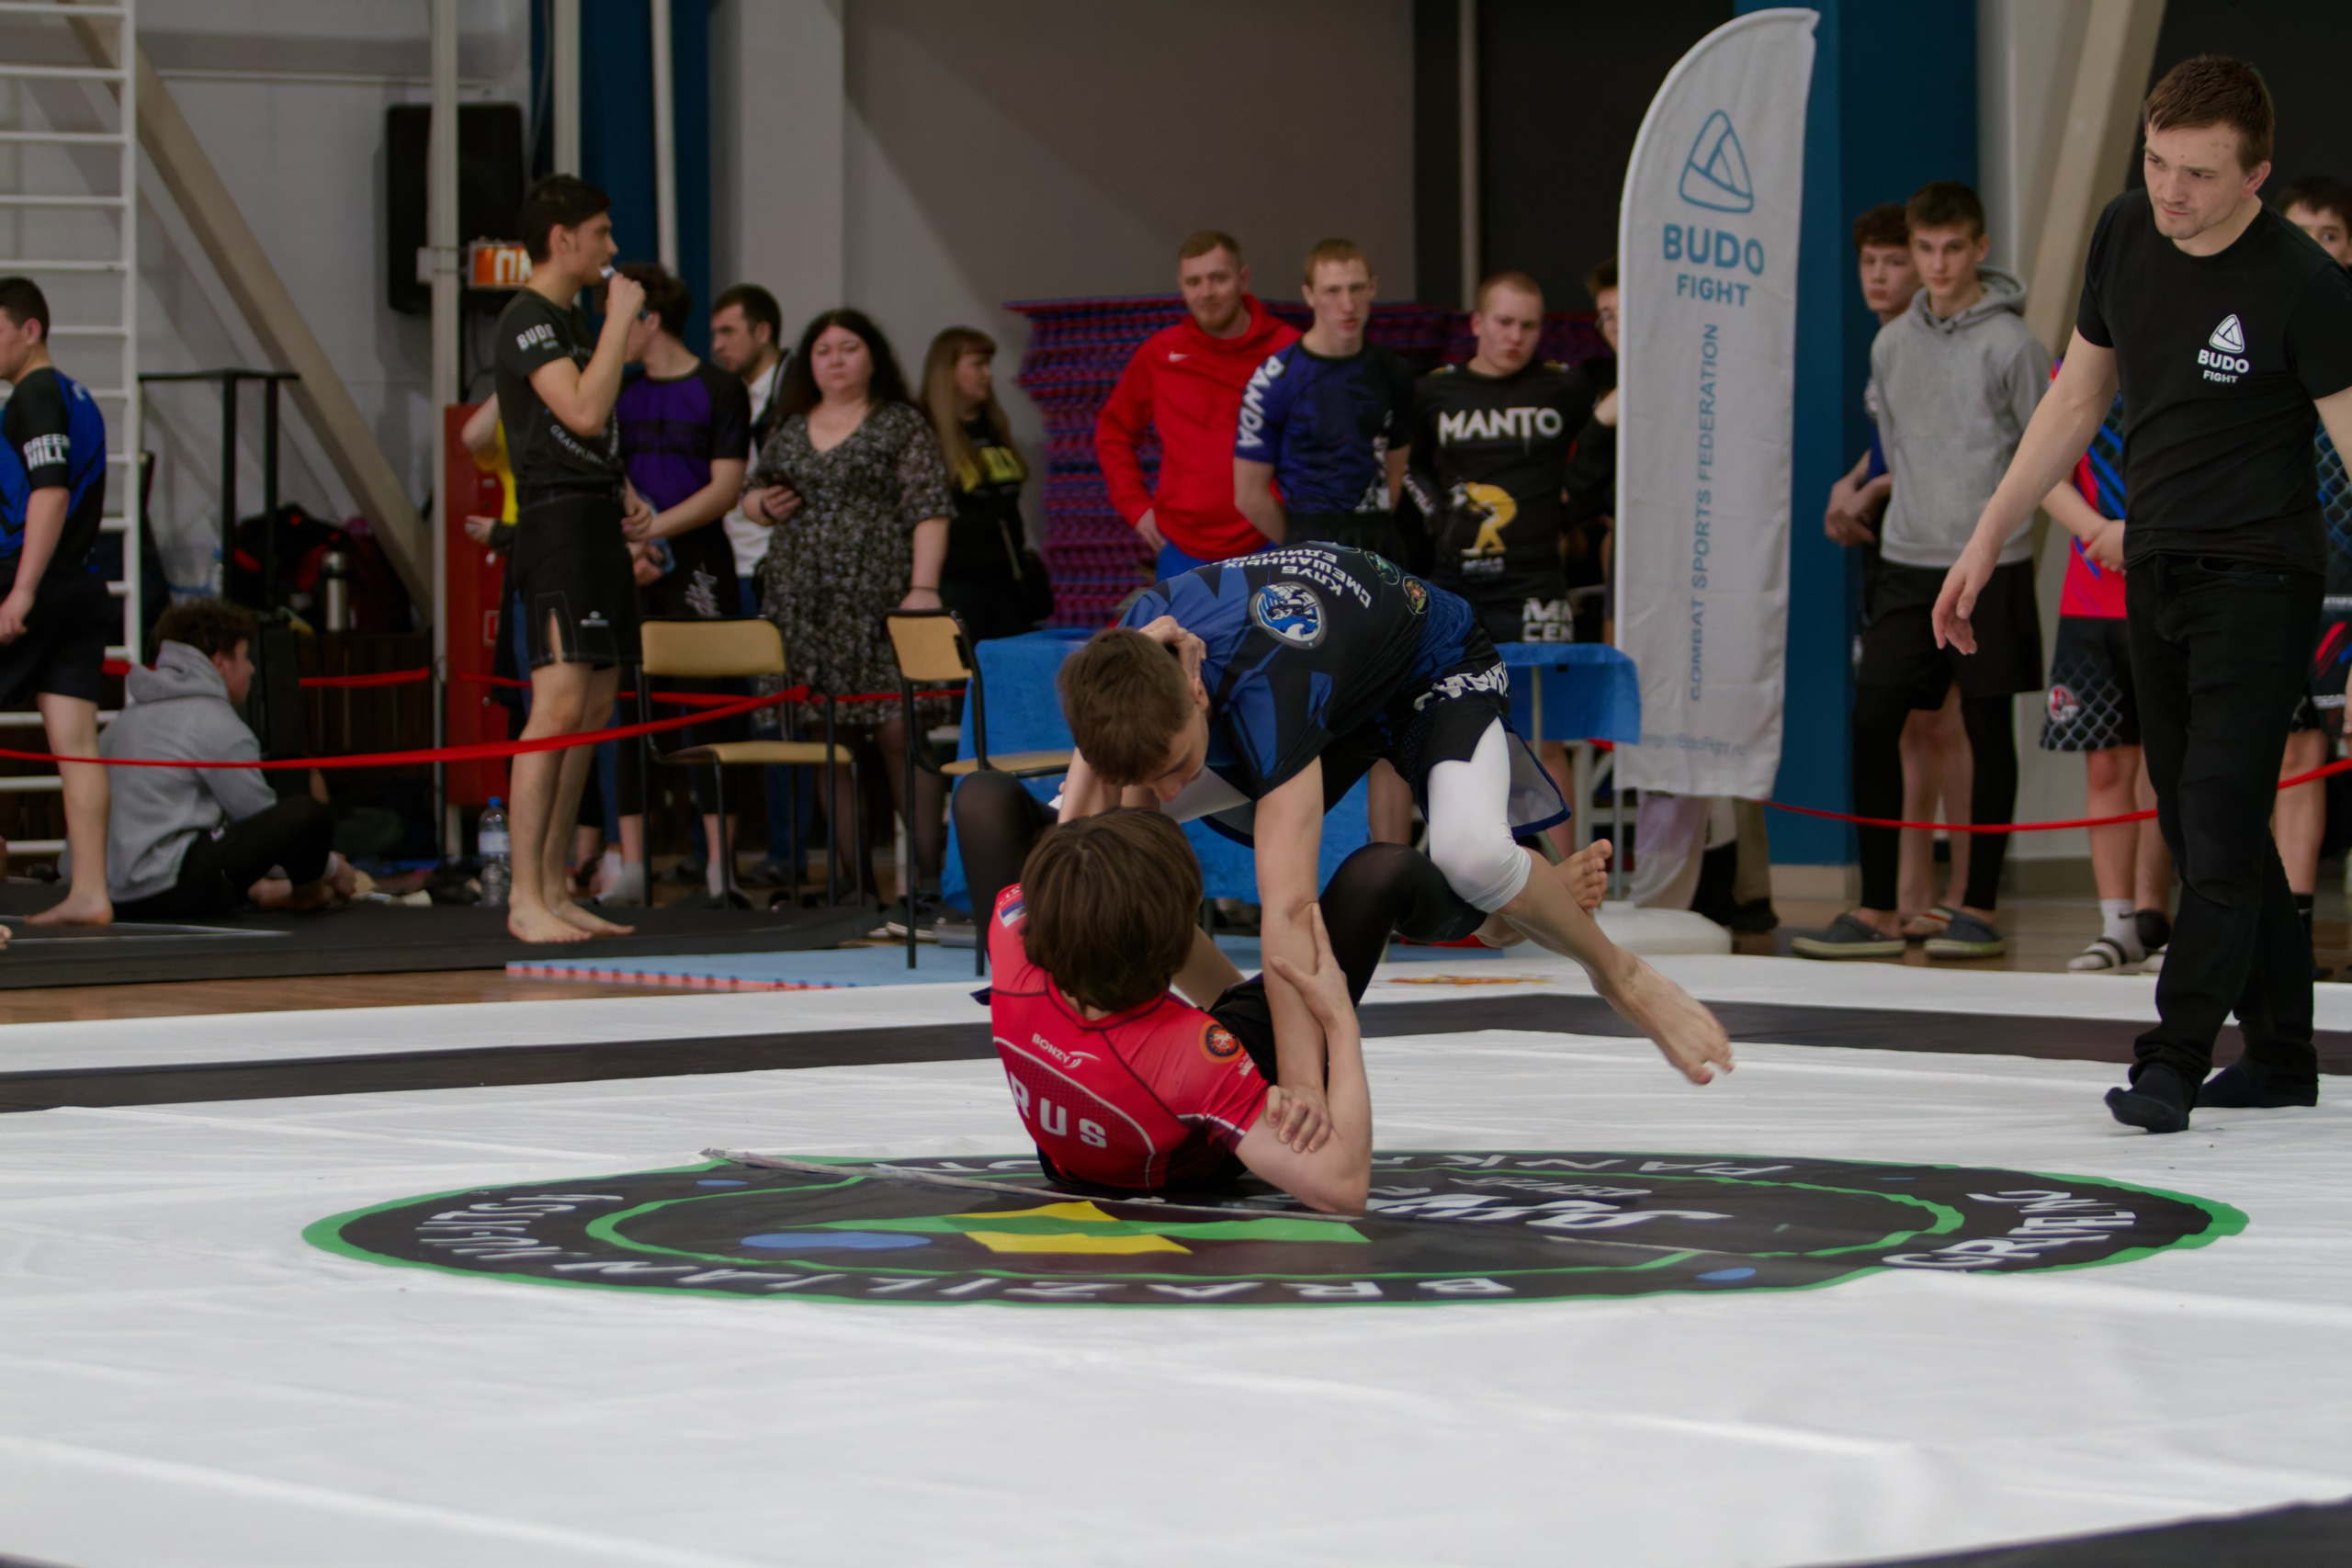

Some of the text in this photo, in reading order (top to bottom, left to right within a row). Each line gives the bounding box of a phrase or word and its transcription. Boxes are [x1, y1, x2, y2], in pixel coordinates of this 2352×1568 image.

[1663, 223, 1765, 276] BUDO
[1677, 274, 1751, 307] FIGHT
[2198, 349, 2250, 374] BUDO
[2203, 369, 2239, 384] FIGHT
[1237, 355, 1286, 449] PANDA
[1439, 407, 1564, 448] MANTO
[26, 445, 67, 471] HILL
[1691, 323, 1720, 702] COMBAT SPORTS FEDERATION
[1223, 555, 1373, 609] СМЕШАННЫХ
[1282, 565, 1343, 597] КЛУБ
[1032, 1032, 1071, 1064] BONZY
[1010, 1071, 1108, 1149] RUS
[551, 1260, 1512, 1300] BRAZILIAN
